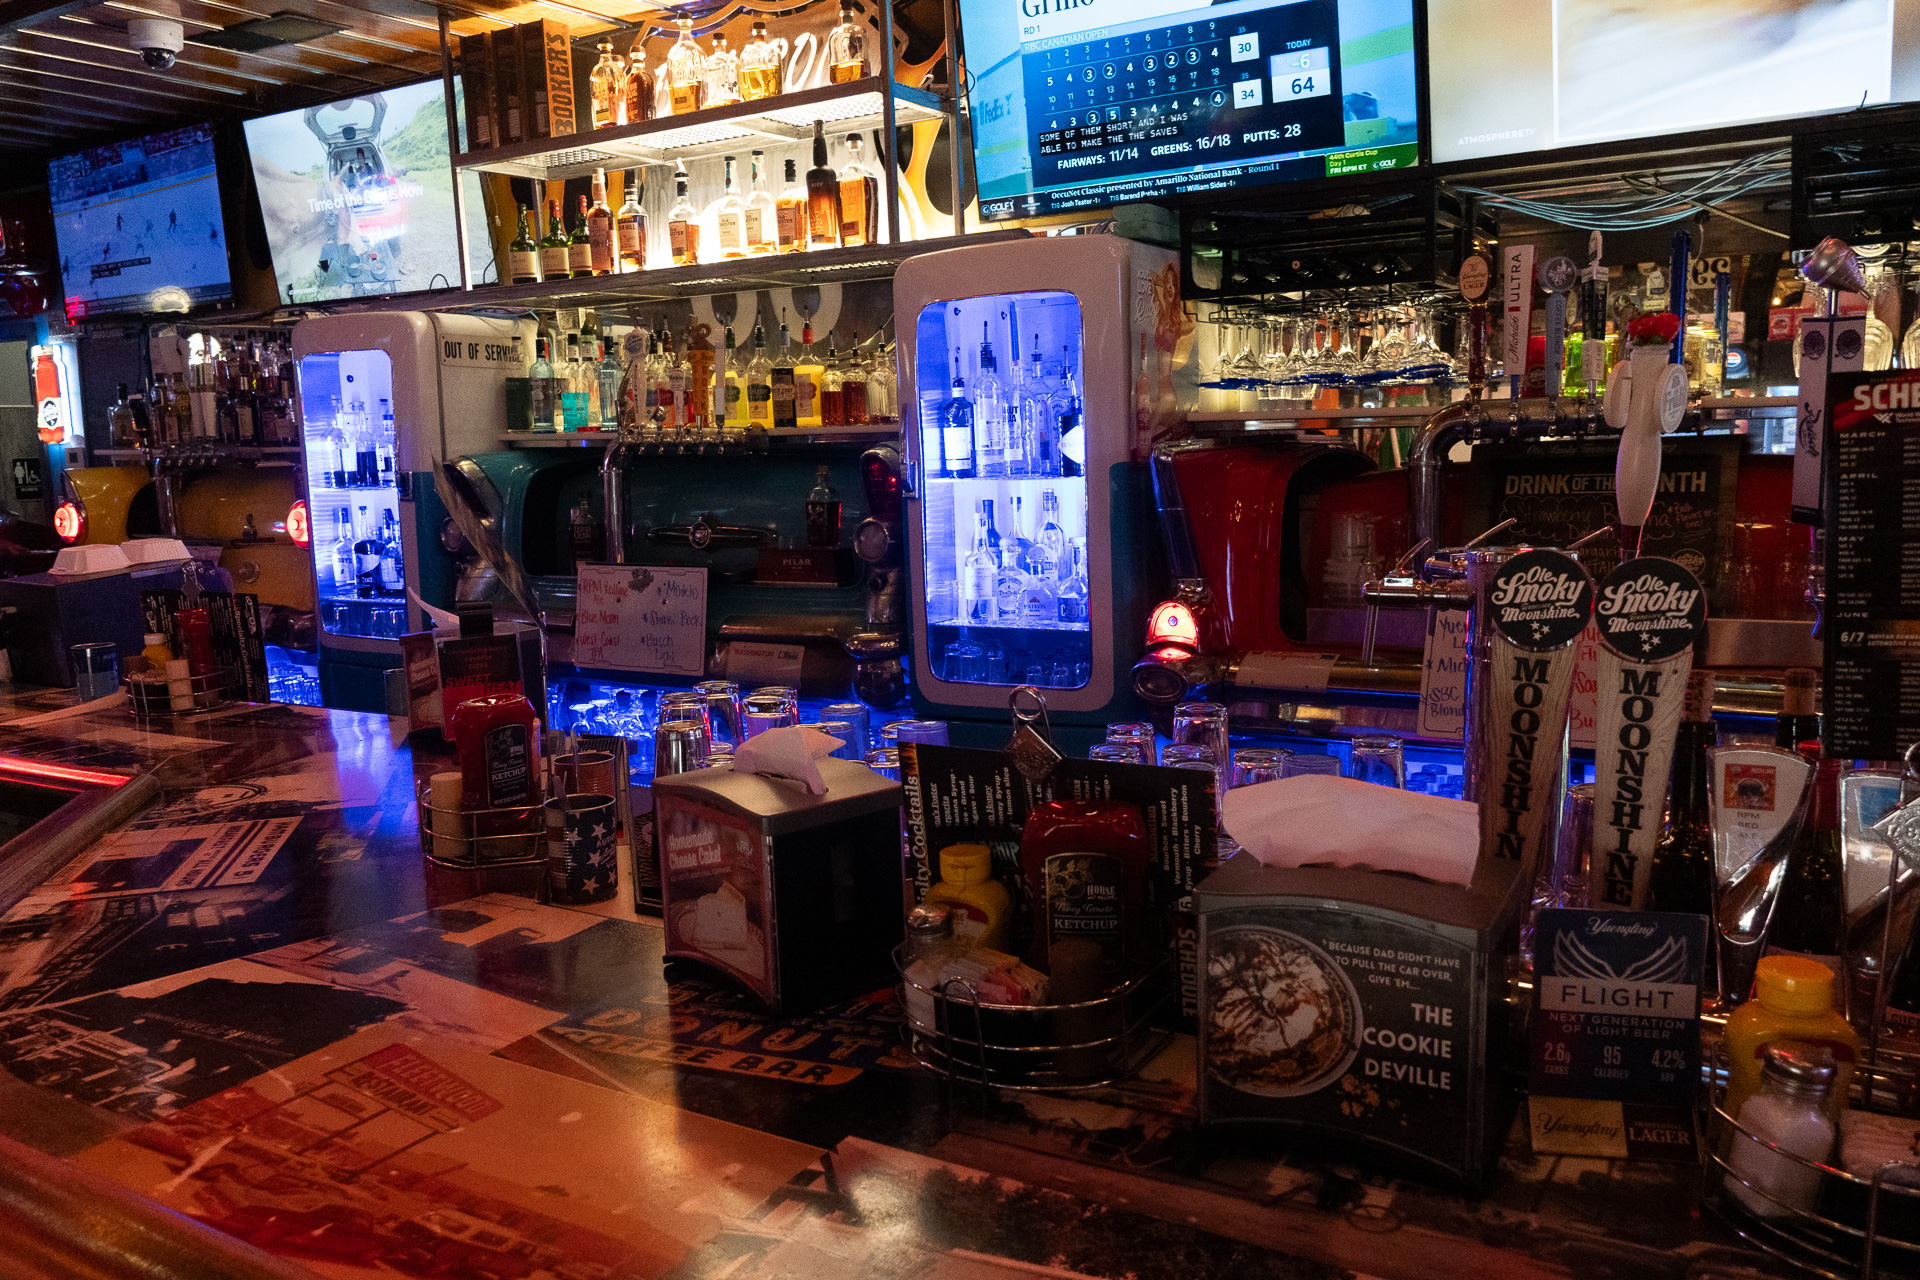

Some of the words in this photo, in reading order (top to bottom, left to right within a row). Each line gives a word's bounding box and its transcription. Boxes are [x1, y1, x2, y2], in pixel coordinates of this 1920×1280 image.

[1024, 26, 1035, 36] RD
[1024, 41, 1041, 52] RBC
[1042, 32, 1085, 49] CANADIAN
[1086, 28, 1108, 40] OPEN
[1285, 38, 1311, 50] TODAY
[1047, 77, 1054, 87] 5
[1066, 73, 1073, 82] 4
[1086, 70, 1092, 79] 3
[1106, 67, 1112, 75] 2
[1126, 62, 1133, 71] 4
[1147, 59, 1153, 68] 3
[1168, 55, 1174, 65] 2
[1189, 51, 1196, 61] 3
[1211, 47, 1218, 57] 4
[1237, 42, 1251, 54] 30
[545, 32, 574, 138] BOOKER'S
[1290, 76, 1314, 95] 64
[1070, 117, 1076, 126] 3
[1110, 110, 1117, 120] 5
[1130, 107, 1137, 117] 3
[1151, 104, 1158, 114] 4
[1171, 100, 1178, 110] 4
[1192, 97, 1199, 106] 4
[1214, 93, 1221, 103] 4
[1241, 89, 1255, 100] 34
[1040, 131, 1061, 143] SOME
[1065, 130, 1076, 139] OF
[1080, 127, 1102, 138] THEM
[1106, 121, 1133, 133] SHORT
[1138, 118, 1155, 128] AND
[1160, 116, 1166, 125] I
[1170, 112, 1188, 123] WAS
[1041, 143, 1062, 155] ABLE
[1066, 140, 1077, 150] TO
[1081, 136, 1103, 148] MAKE
[1108, 133, 1124, 144] THE
[1129, 130, 1145, 141] THE
[1150, 126, 1178, 139] SAVES
[1057, 155, 1106, 170] FAIRWAYS:
[1108, 147, 1139, 163] 11/14
[1150, 142, 1192, 156] GREENS:
[1196, 134, 1231, 150] 16/18
[1243, 131, 1280, 144] PUTTS:
[1284, 124, 1302, 138] 28
[1379, 159, 1396, 168] GOLF
[1051, 189, 1080, 200] OccuNet
[1081, 185, 1105, 197] Classic
[1107, 180, 1143, 195] presented
[1143, 180, 1154, 190] by
[1154, 174, 1187, 187] Amarillo
[1188, 168, 1222, 182] National
[1222, 167, 1243, 179] Bank
[1248, 164, 1275, 174] Round
[307, 198, 334, 213] Time
[334, 196, 345, 208] of
[346, 193, 363, 207] the
[399, 184, 424, 197] Now
[1462, 282, 1485, 290] LAGER
[1510, 253, 1522, 304] ULTRA
[444, 341, 462, 359] OUT
[468, 343, 479, 360] OF
[1508, 316, 1519, 365] Michelob
[1839, 431, 1886, 439] MARCH
[1504, 473, 1571, 496] DRINK
[1571, 476, 1589, 491] OF
[782, 558, 812, 567] PILAR
[1525, 565, 1557, 583] Ole
[1634, 573, 1668, 592] Ole
[582, 579, 603, 593] RPM
[666, 581, 699, 599] Modelo
[1491, 572, 1585, 607] Smoky
[1598, 581, 1699, 616] Smoky
[581, 610, 600, 624] Blue
[600, 613, 619, 624] Moon
[680, 610, 702, 627] Bock
[1501, 606, 1580, 622] Moonshine
[1607, 615, 1693, 634] Moonshine
[581, 634, 602, 646] West
[646, 634, 674, 647] Busch
[1840, 631, 1865, 643] 6/7
[589, 648, 604, 661] IPA
[734, 649, 774, 659] WASHINGTON
[446, 673, 491, 688] SWEET
[484, 680, 521, 693] HEAT
[1428, 686, 1458, 702] SBC
[1496, 657, 1551, 861] MOONSHIN
[491, 766, 527, 781] KETCHUP
[1003, 766, 1011, 787] slice
[959, 780, 968, 806] Grand
[994, 774, 1003, 800] Syrup
[1604, 668, 1662, 907] MOONSHINE
[985, 784, 994, 814] Honey
[1005, 789, 1013, 816] lemon
[1180, 784, 1188, 822] Bourbon
[907, 775, 929, 861] Cocktails
[1170, 787, 1179, 836] Blackberry
[1737, 811, 1760, 820] RPM
[1738, 821, 1759, 830] RED
[1739, 832, 1758, 840] ALE
[669, 828, 715, 851] Homemade
[1183, 828, 1191, 859] Bitters
[669, 852, 698, 870] Cheese
[1184, 866, 1194, 891] Syrup
[1086, 884, 1116, 896] HOUSE
[1054, 918, 1118, 930] KETCHUP
[1585, 917, 1658, 938] Yuengling
[1328, 941, 1371, 958] BECAUSE
[1373, 947, 1395, 961] DAD
[1397, 949, 1432, 966] DIDN'T
[1434, 955, 1460, 969] HAVE
[1178, 927, 1198, 1018] SCHEDULE
[1335, 954, 1349, 967] TO
[1351, 957, 1376, 971] PULL
[1377, 960, 1397, 973] THE
[1399, 963, 1420, 977] CAR
[1421, 967, 1453, 982] OVER,
[1368, 972, 1390, 986] GIVE
[1561, 984, 1675, 1010] FLIGHT
[1410, 1002, 1453, 1027] THE
[1549, 1011, 1586, 1025] NEXT
[1591, 1014, 1686, 1031] GENERATION
[1561, 1023, 1582, 1034] OF
[1586, 1026, 1629, 1039] LIGHT
[1633, 1028, 1673, 1040] BEER
[1363, 1027, 1452, 1059] COOKIE
[1543, 1041, 1571, 1062] 2.6g
[1603, 1045, 1621, 1065] 95
[1650, 1048, 1686, 1070] 4.2%
[738, 1053, 833, 1083] BAR
[1364, 1058, 1451, 1091] DEVILLE
[1544, 1064, 1569, 1076] CARBS
[1593, 1066, 1630, 1080] CALORIES
[1536, 1112, 1622, 1139] Yuengling
[1628, 1126, 1690, 1146] LAGER
